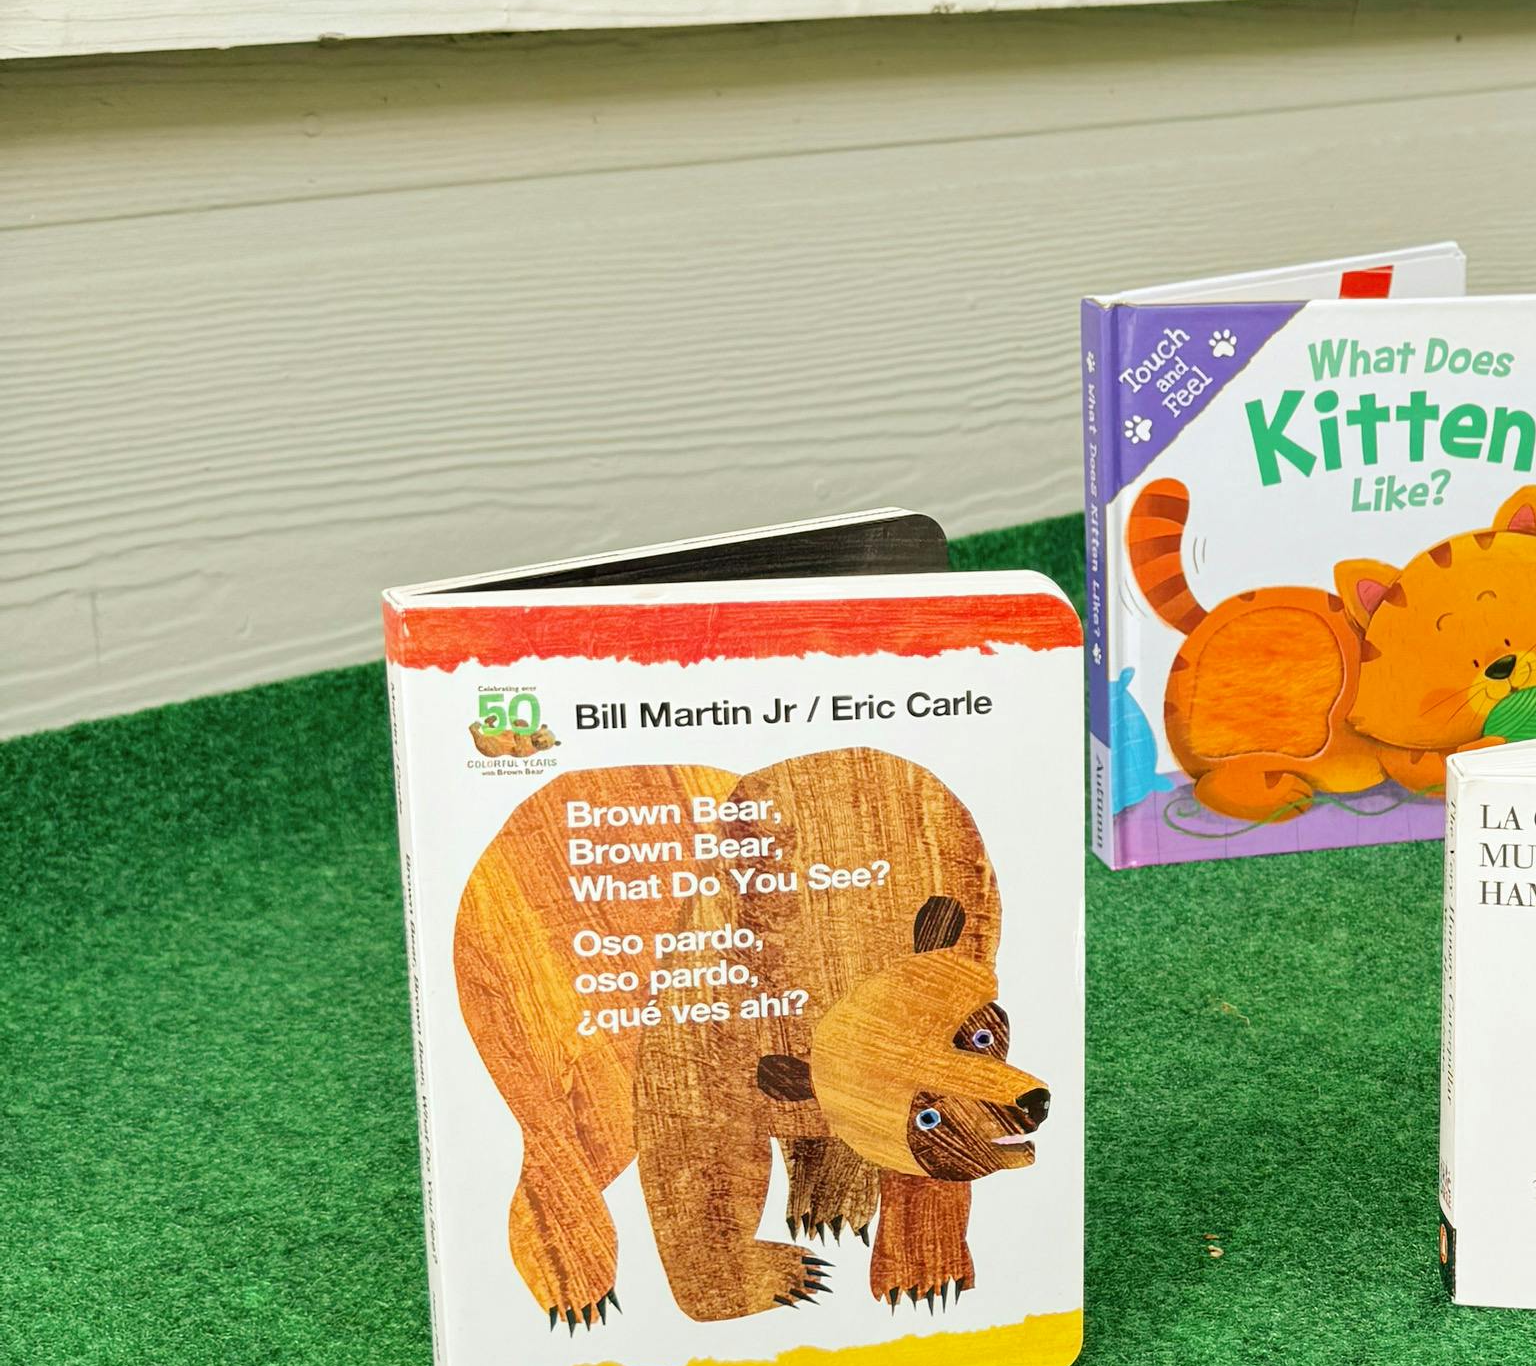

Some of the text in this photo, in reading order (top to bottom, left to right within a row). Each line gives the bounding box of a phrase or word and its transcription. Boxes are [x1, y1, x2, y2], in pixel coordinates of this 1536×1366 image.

[1118, 328, 1190, 393] Touch
[1156, 355, 1189, 392] and
[1308, 338, 1515, 381] What Does
[1162, 366, 1213, 417] Feel
[1245, 390, 1536, 487] Kitten
[1088, 383, 1100, 637] What Does Kitten Like?
[1351, 470, 1451, 512] Like?
[478, 693, 540, 735] 50
[576, 703, 627, 729] Bill
[640, 698, 751, 728] Martin
[762, 697, 797, 723] Jr
[832, 694, 895, 720] Eric
[907, 689, 993, 718] Carle
[467, 760, 518, 768] COLORFUL
[567, 795, 782, 827] Brown Bear,
[1478, 804, 1521, 829] LA
[569, 834, 783, 864] Brown Bear,
[570, 861, 891, 902] What Do You See?
[573, 927, 764, 960] Oso pardo,
[575, 962, 759, 995] oso pardo,
[577, 989, 809, 1035] ¿qué ves ahí?
